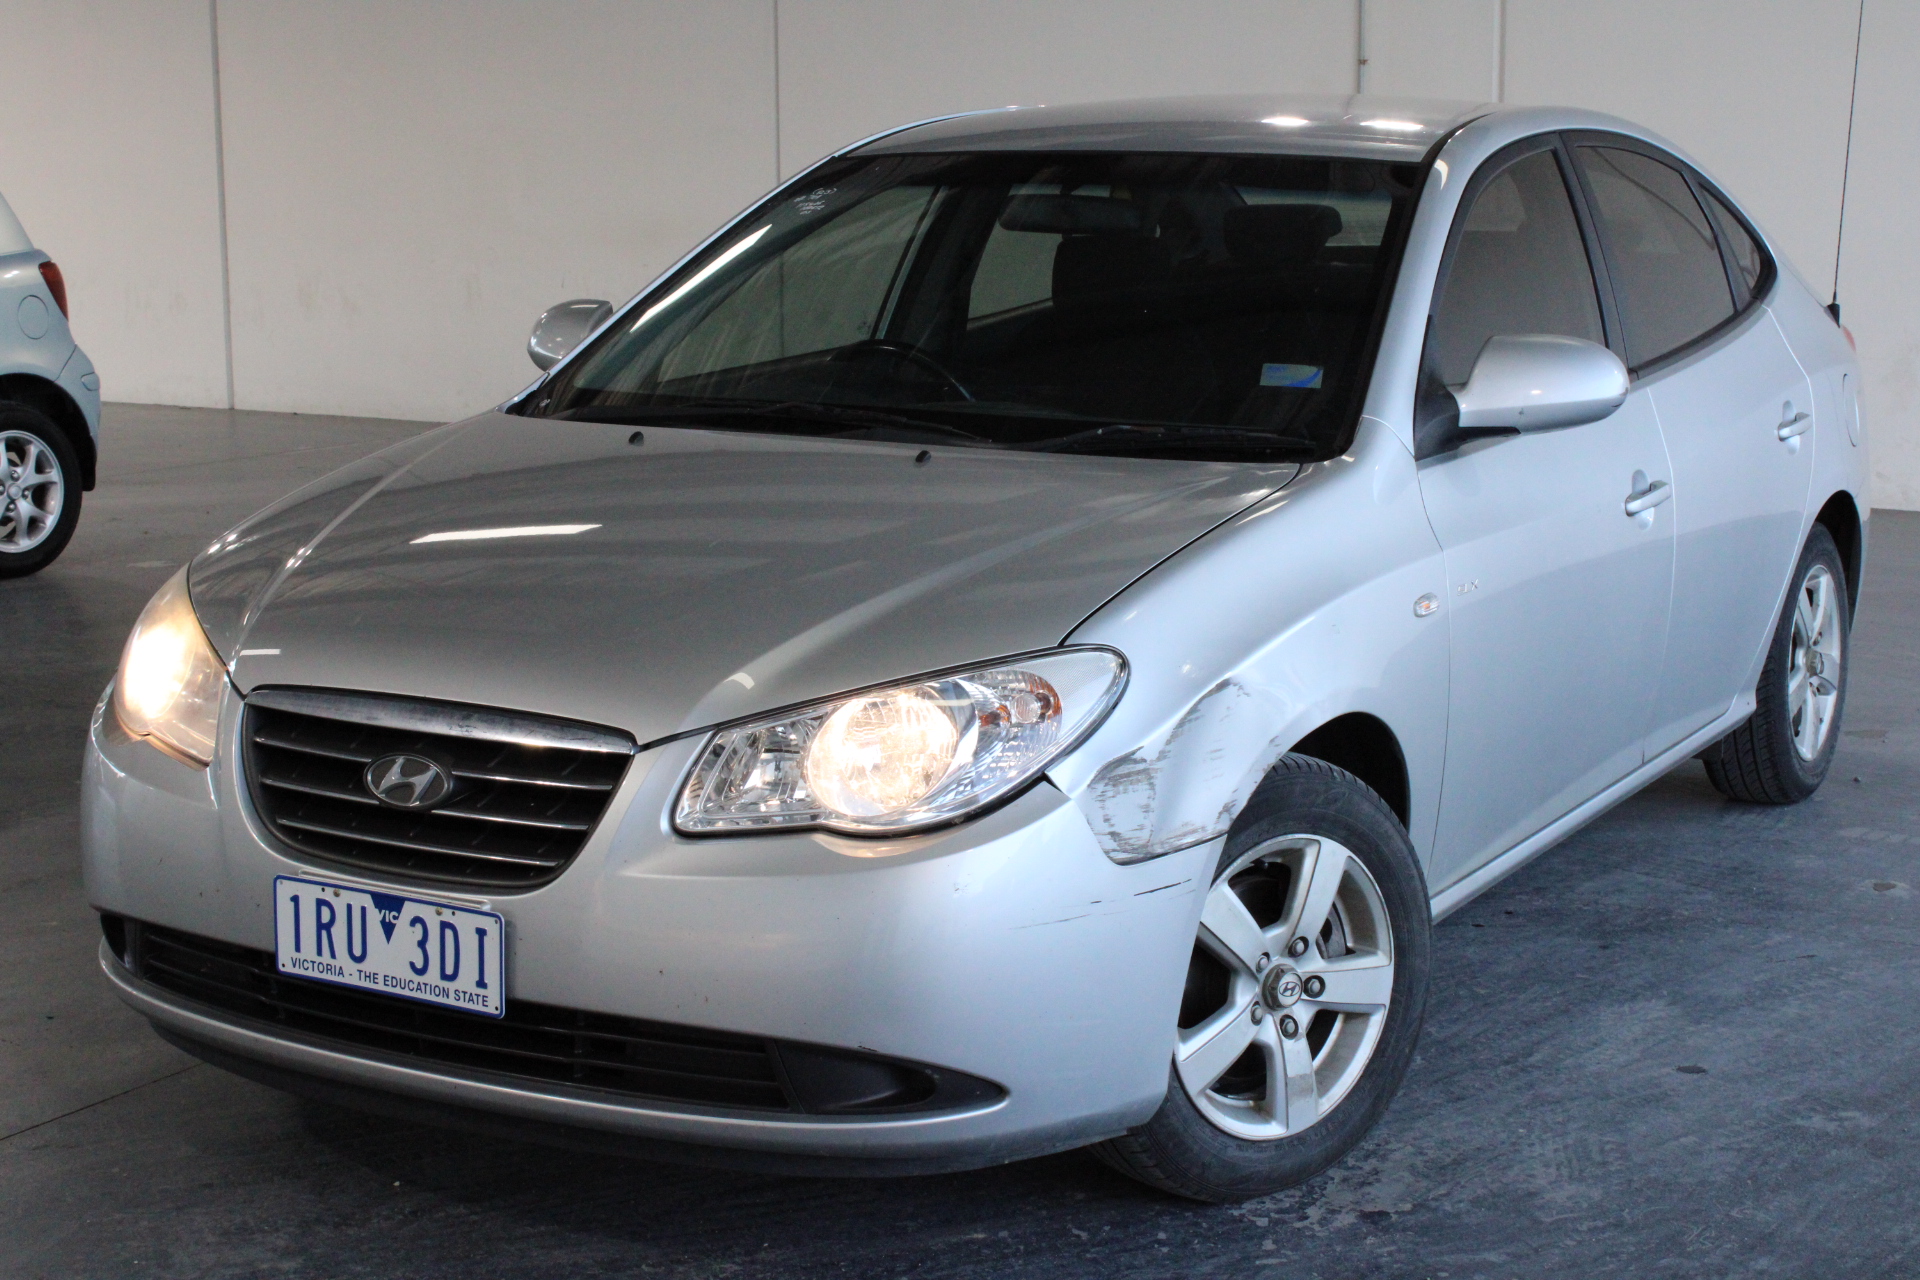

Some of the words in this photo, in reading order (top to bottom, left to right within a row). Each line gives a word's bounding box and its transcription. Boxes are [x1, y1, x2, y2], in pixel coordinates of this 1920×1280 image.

[290, 894, 368, 964] 1RU
[409, 915, 488, 990] 3DI
[377, 908, 400, 924] VIC
[291, 956, 345, 978] VICTORIA
[357, 969, 379, 985] THE
[383, 974, 450, 1000] EDUCATION
[453, 989, 489, 1008] STATE
